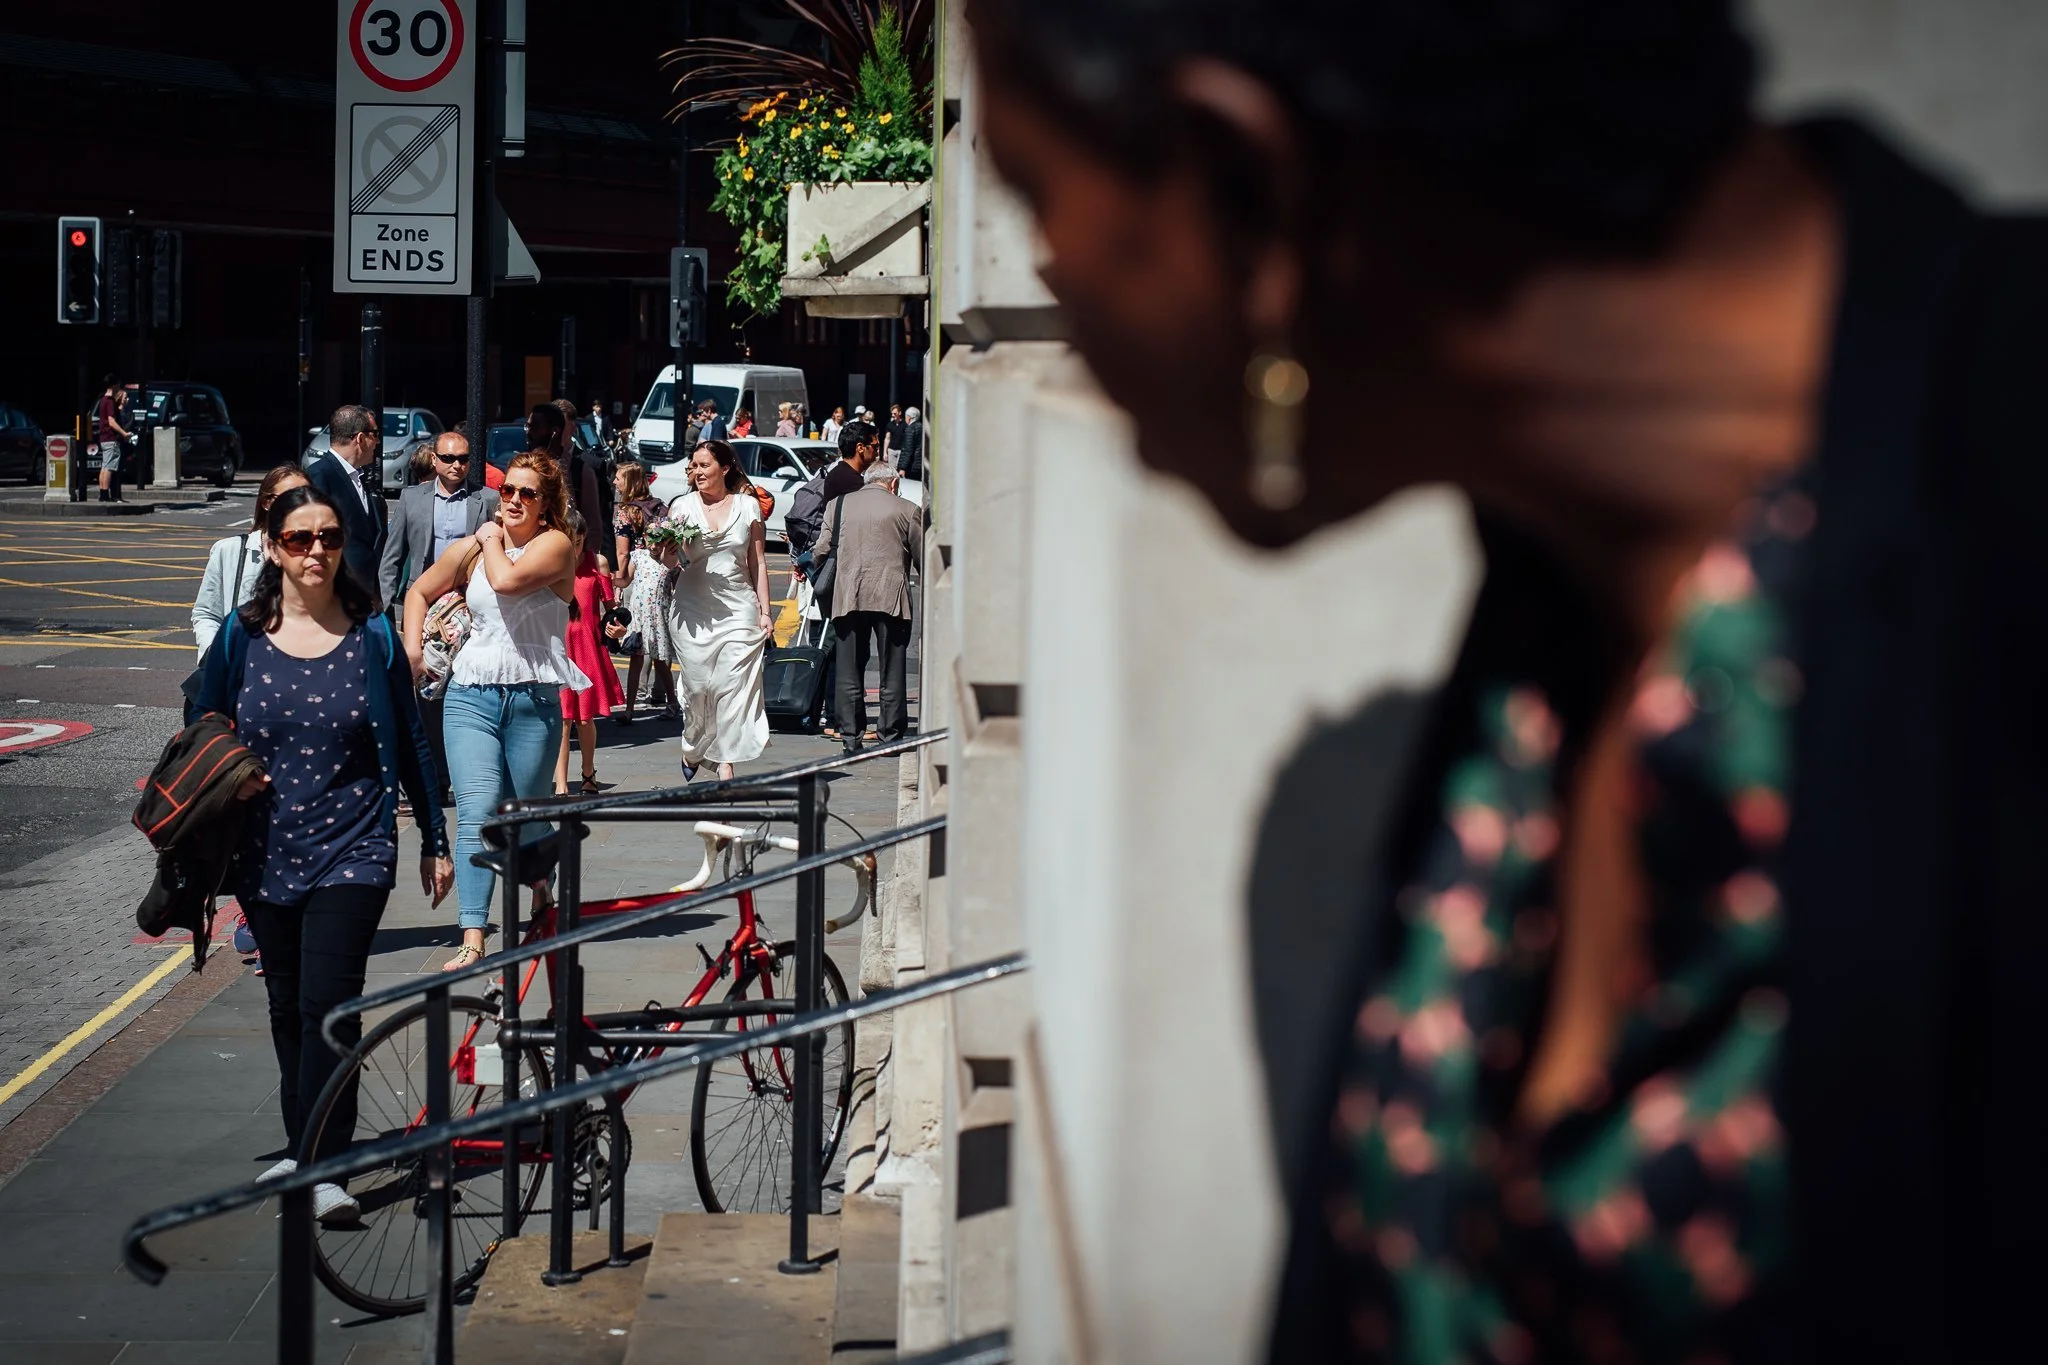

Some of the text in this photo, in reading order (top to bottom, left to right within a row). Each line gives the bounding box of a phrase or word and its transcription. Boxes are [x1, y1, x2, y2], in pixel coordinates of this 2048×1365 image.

[366, 10, 447, 57] 30
[377, 224, 429, 242] Zone
[362, 249, 445, 272] ENDS
